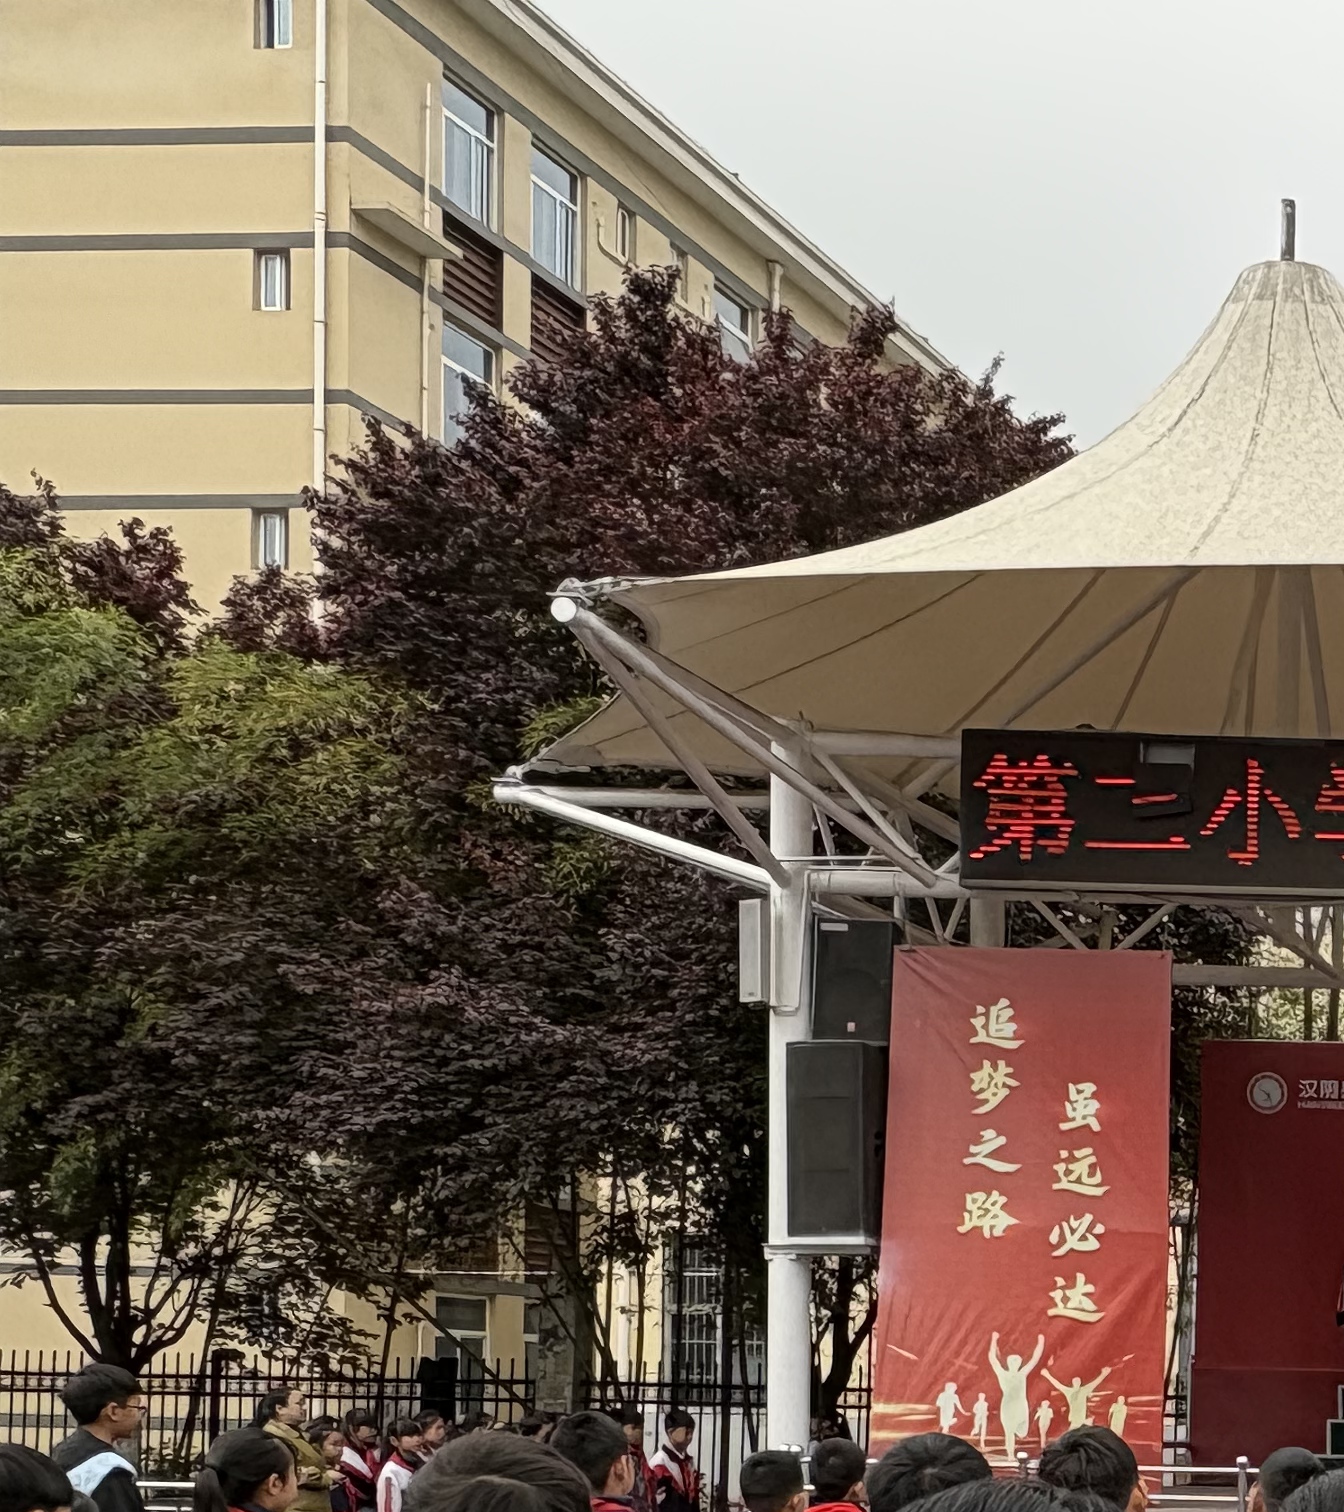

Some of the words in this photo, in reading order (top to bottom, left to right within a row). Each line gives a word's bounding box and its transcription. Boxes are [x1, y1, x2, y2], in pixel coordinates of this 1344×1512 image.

[956, 997, 1026, 1239] 追梦之路
[1046, 1081, 1112, 1324] 虽远必达
